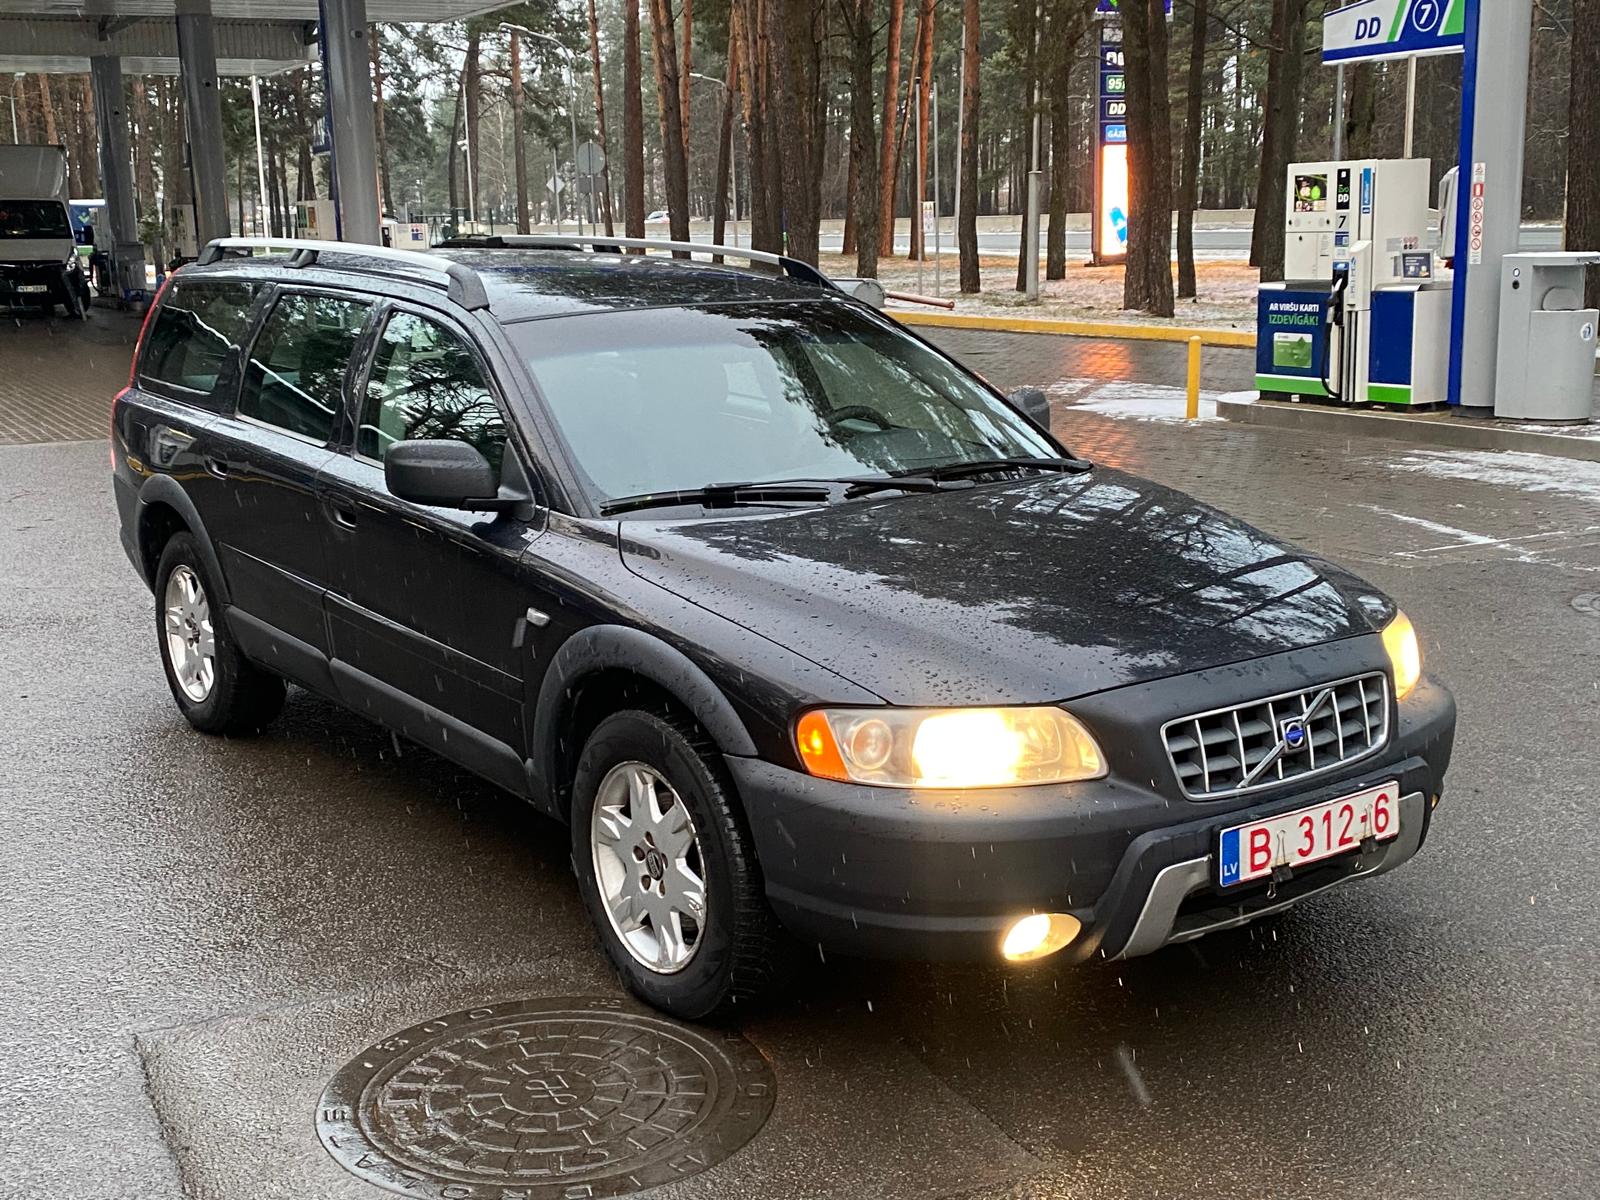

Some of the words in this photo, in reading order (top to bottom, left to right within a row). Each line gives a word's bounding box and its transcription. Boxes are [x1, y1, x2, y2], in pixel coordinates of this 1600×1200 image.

[1419, 3, 1432, 25] 7
[1355, 16, 1381, 40] DD
[1338, 194, 1349, 203] DD
[1338, 215, 1347, 228] 7
[1269, 302, 1279, 311] AR
[1279, 301, 1299, 311] VIRŠU
[1299, 303, 1319, 312] KARTI
[1268, 313, 1319, 326] IZDEVĪGĀK!
[1249, 827, 1272, 873] B
[1223, 861, 1239, 876] LV
